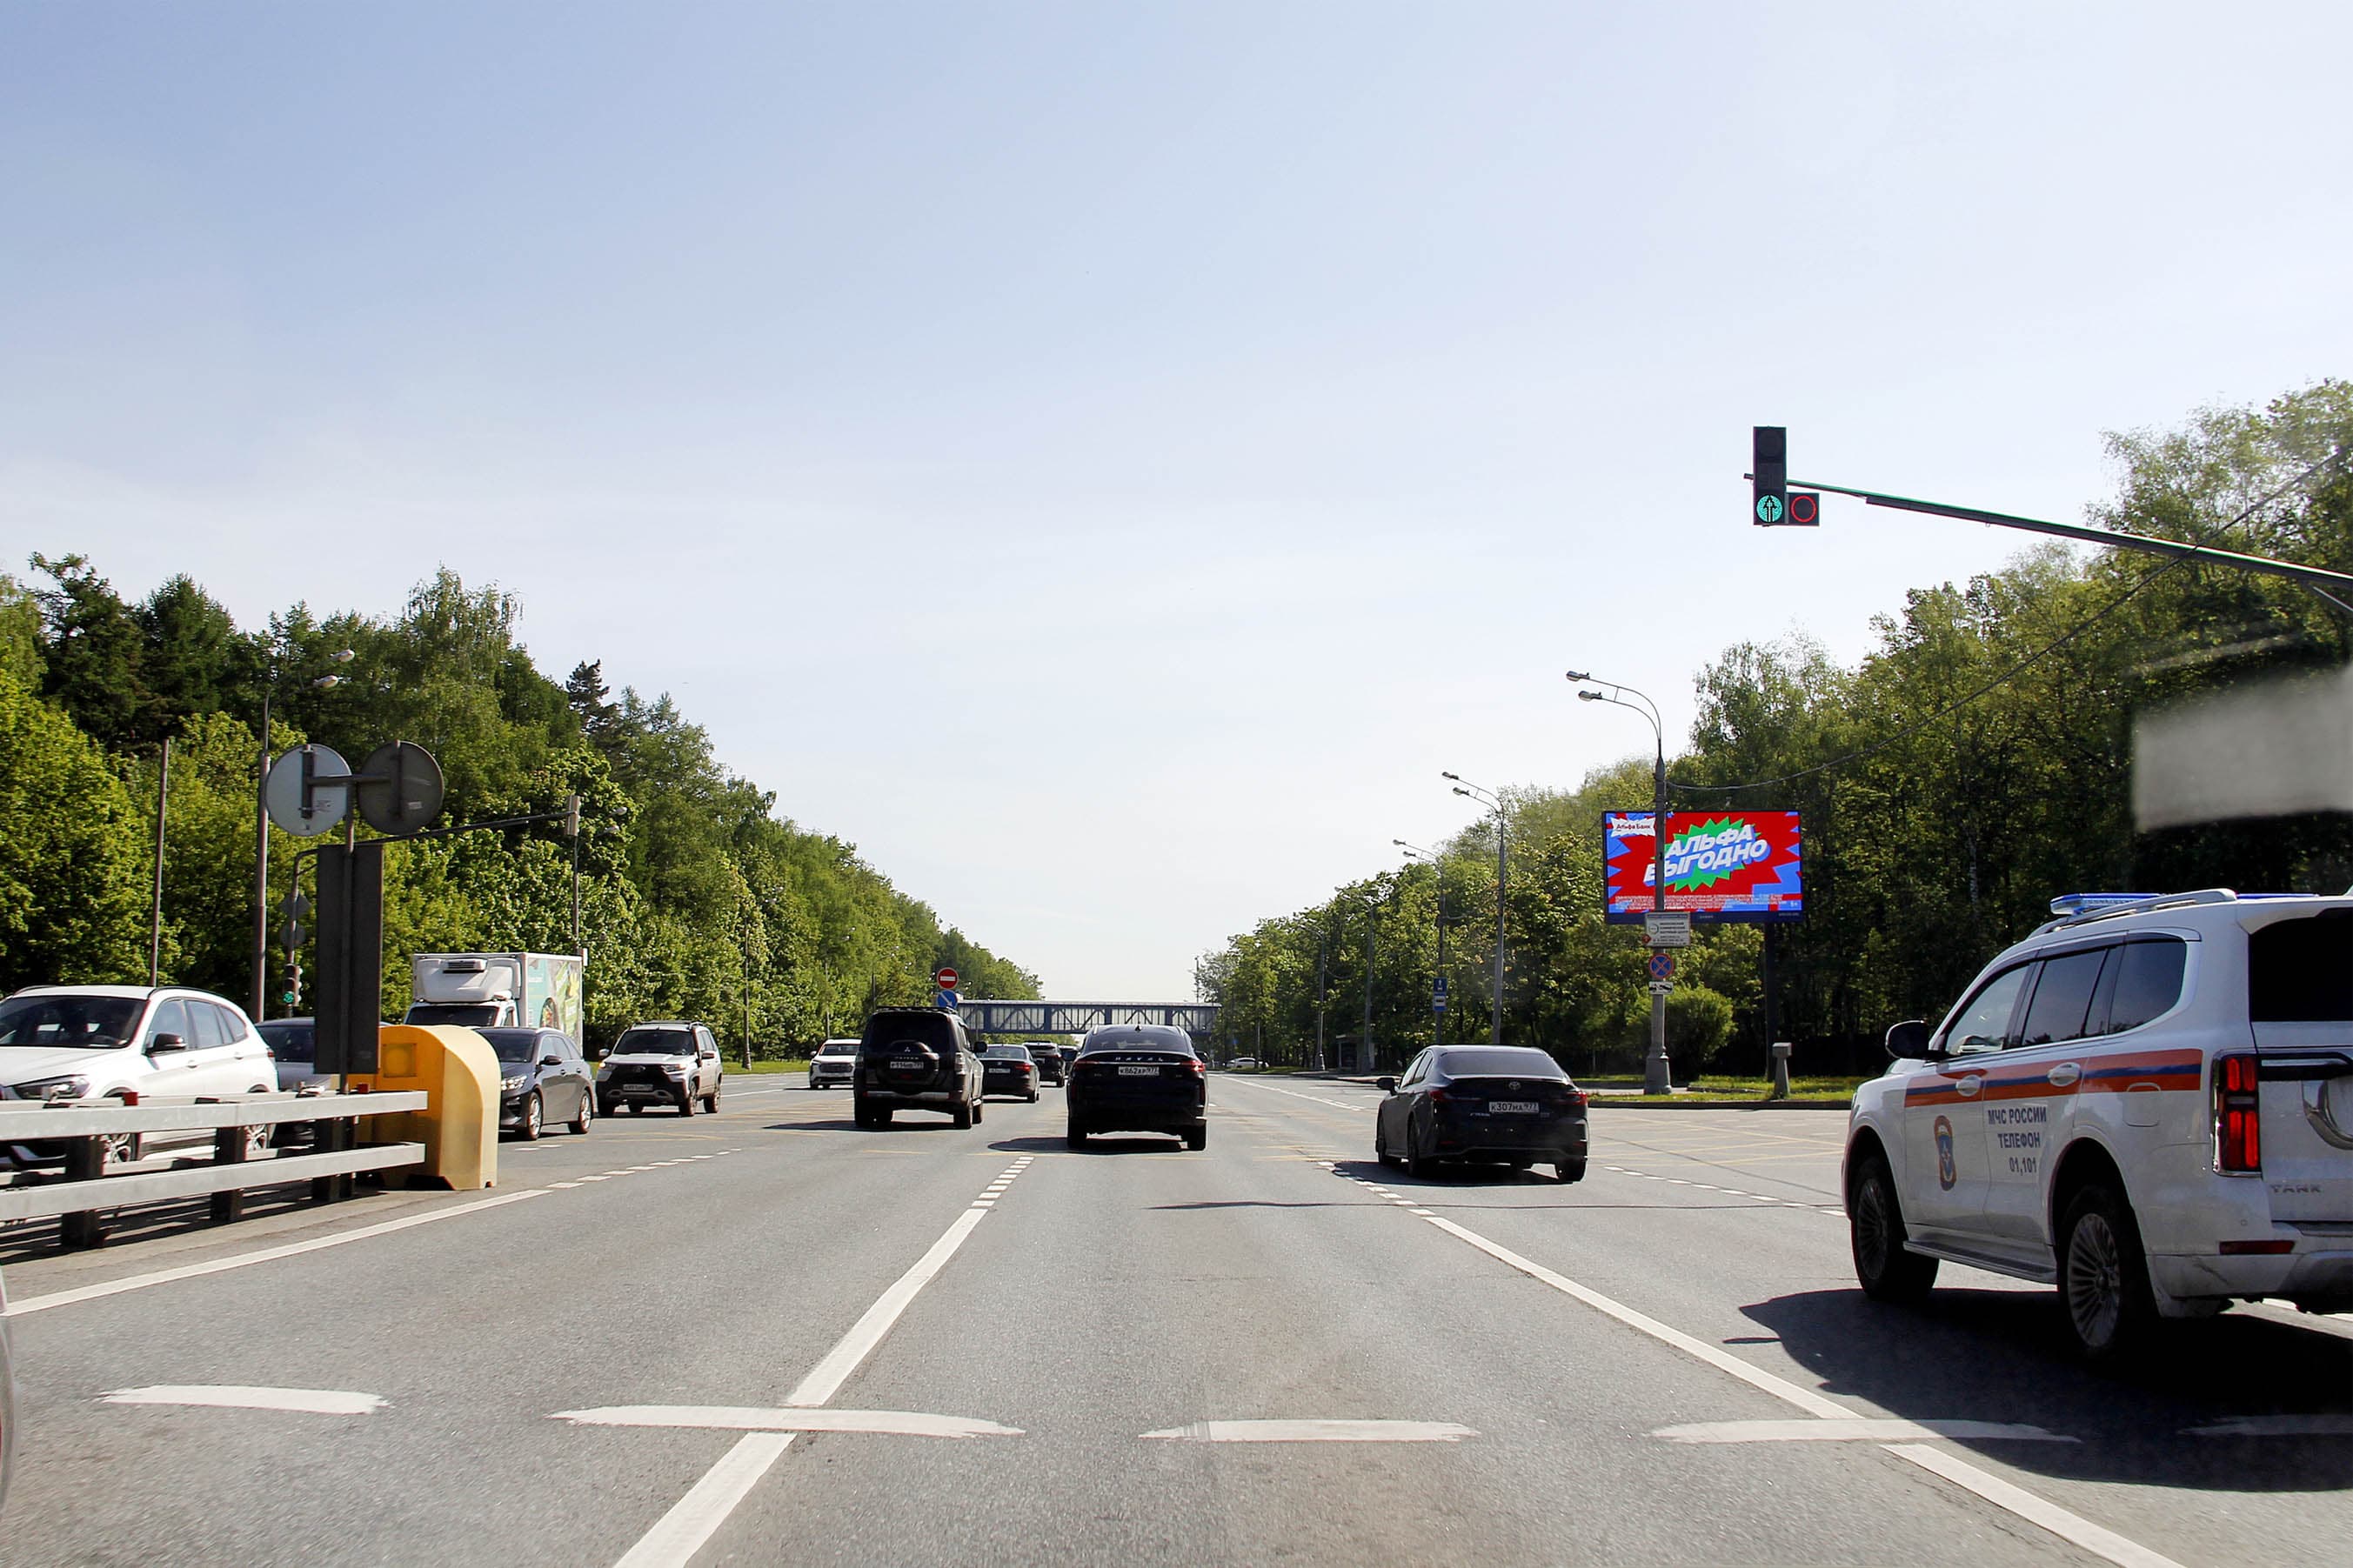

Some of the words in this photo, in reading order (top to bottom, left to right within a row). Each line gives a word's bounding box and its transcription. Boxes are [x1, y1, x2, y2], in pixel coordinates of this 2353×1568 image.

[1664, 824, 1753, 858] АЛЬФА
[1643, 839, 1768, 882] ВЫГОДНО
[1988, 1109, 2007, 1124] МЧС
[2009, 1106, 2047, 1124] РОССИИ
[1997, 1132, 2041, 1149] ТЕЛЕФОН
[2009, 1157, 2037, 1176] 01,101
[2269, 1184, 2322, 1193] TANK
